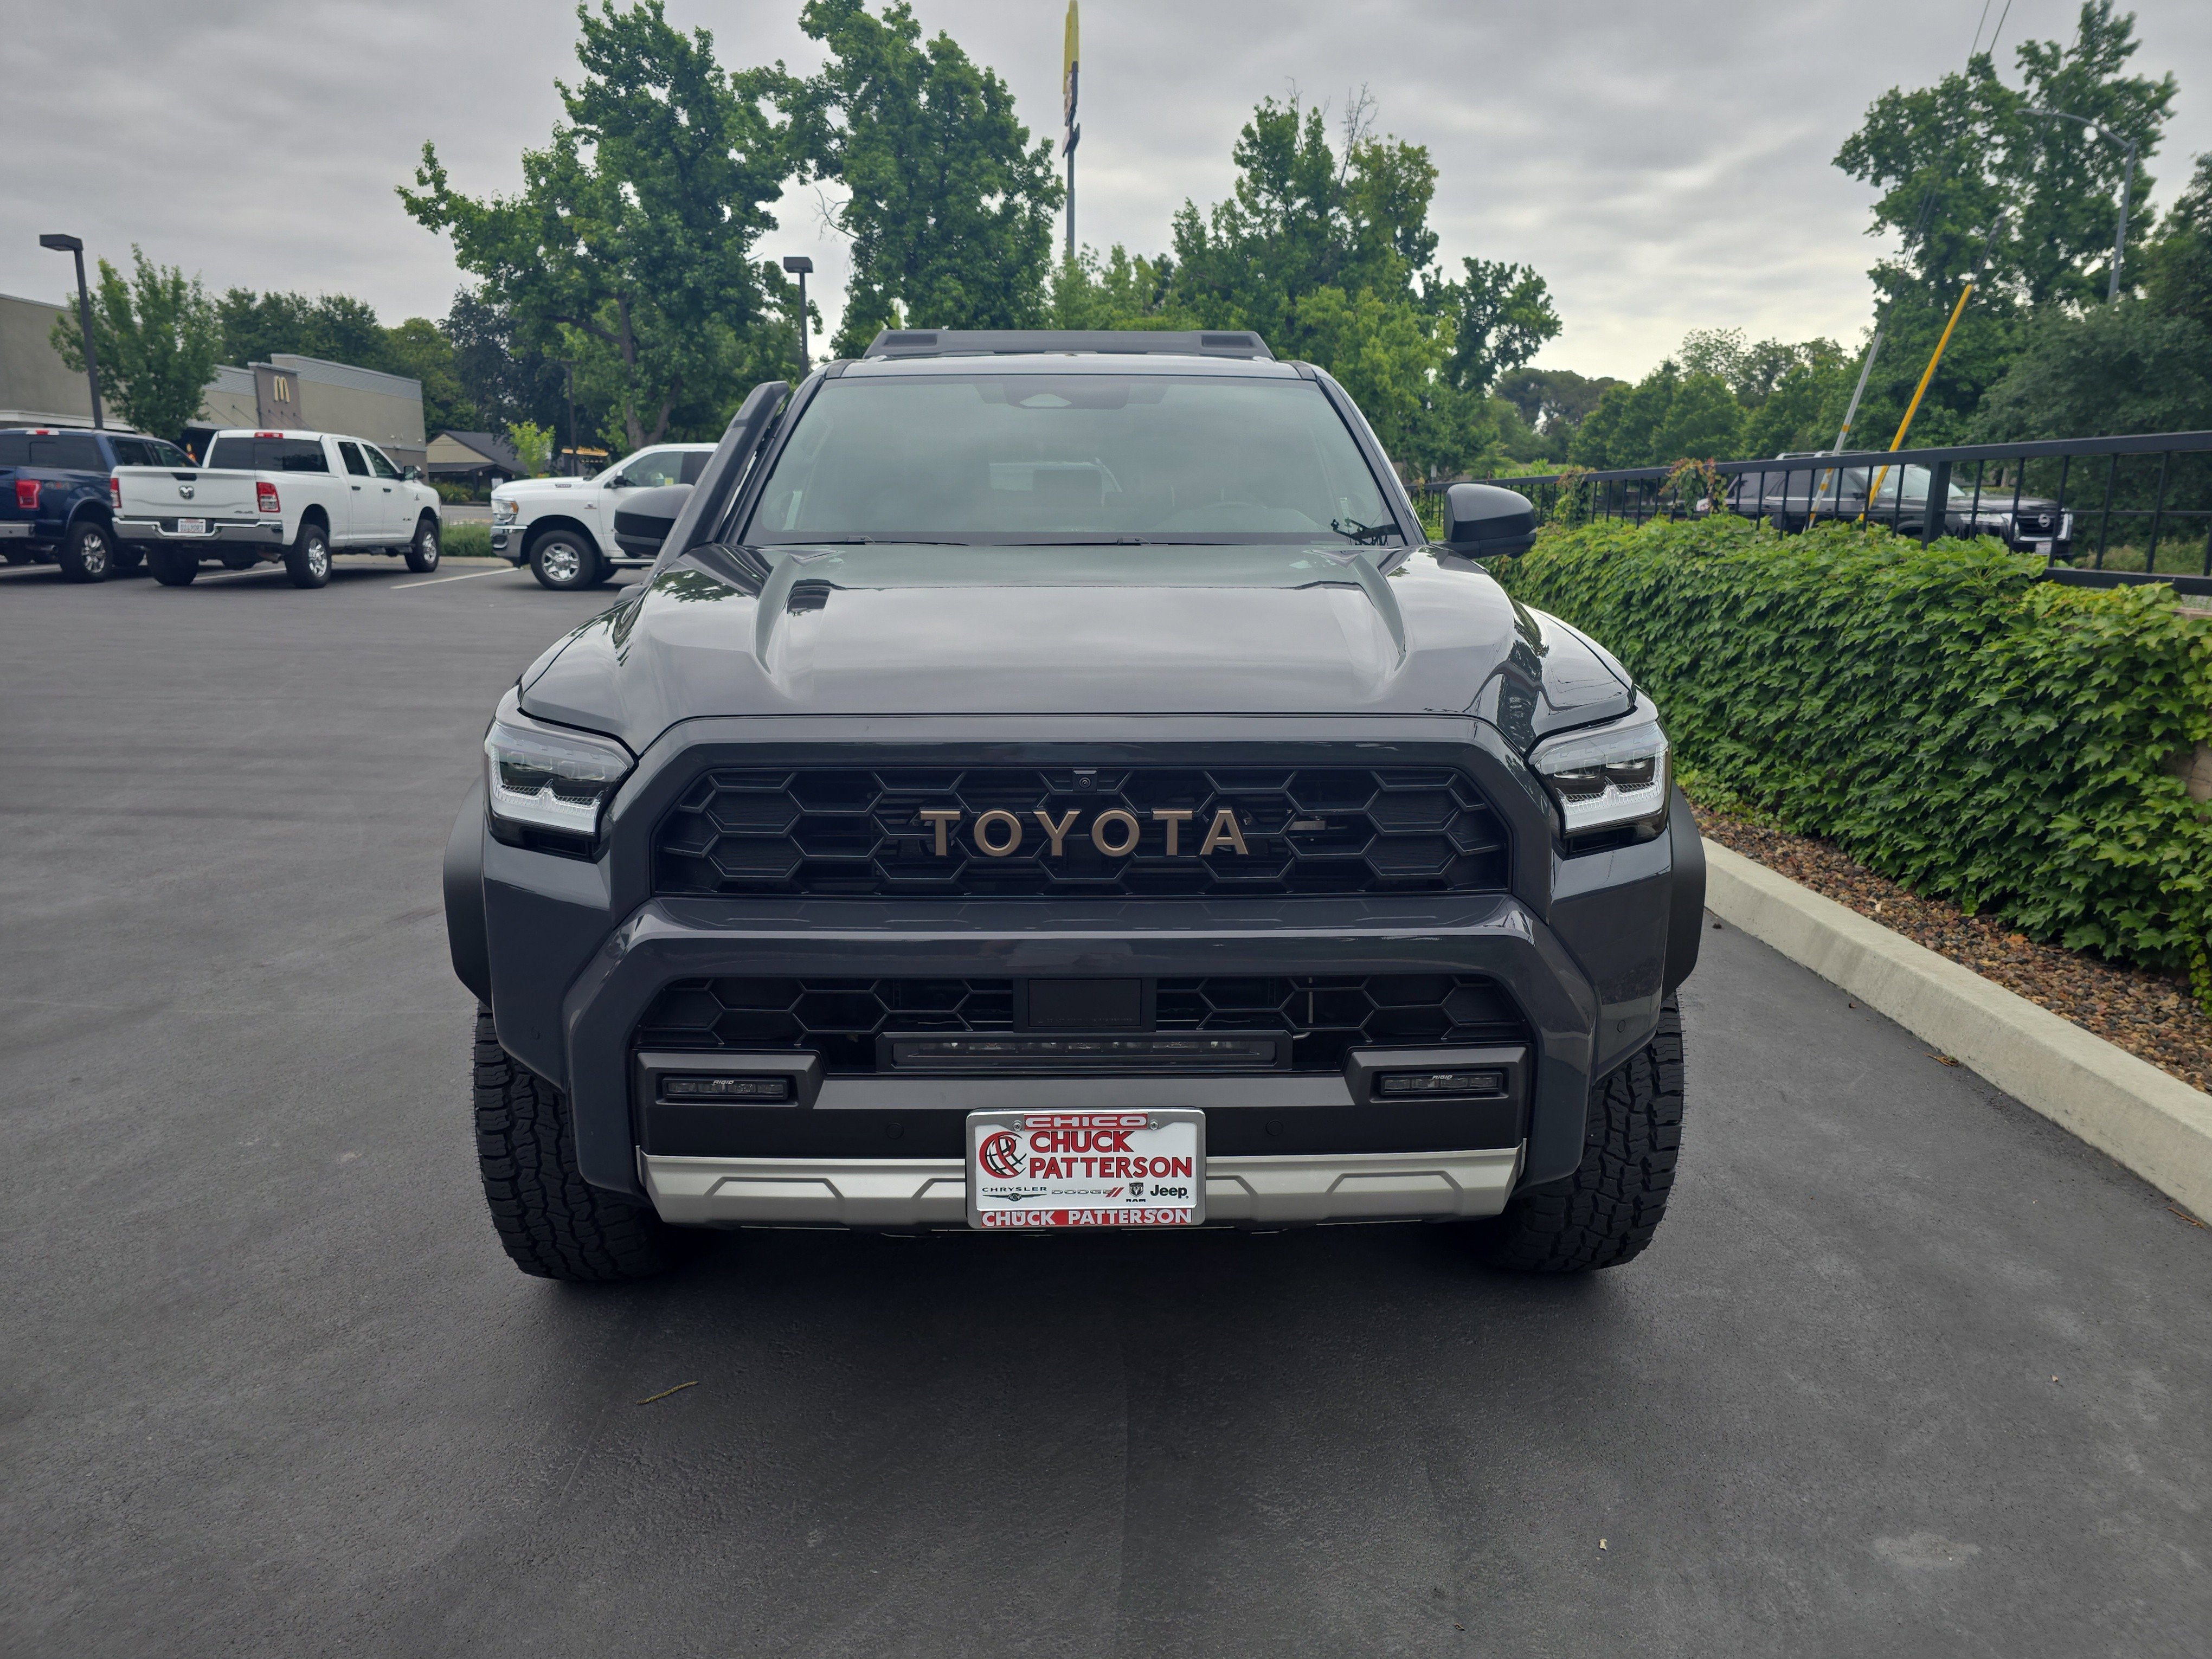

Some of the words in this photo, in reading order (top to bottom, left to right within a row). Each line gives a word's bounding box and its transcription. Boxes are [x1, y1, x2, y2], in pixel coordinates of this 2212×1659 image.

[920, 809, 1249, 857] TOYOTA
[1025, 1116, 1147, 1128] CHICO
[1030, 1130, 1135, 1153] CHUCK
[1030, 1156, 1192, 1179] PATTERSON
[1150, 1185, 1188, 1199] Jeep
[982, 1211, 1056, 1226] CHUCK
[1068, 1208, 1193, 1225] PATTERSON
